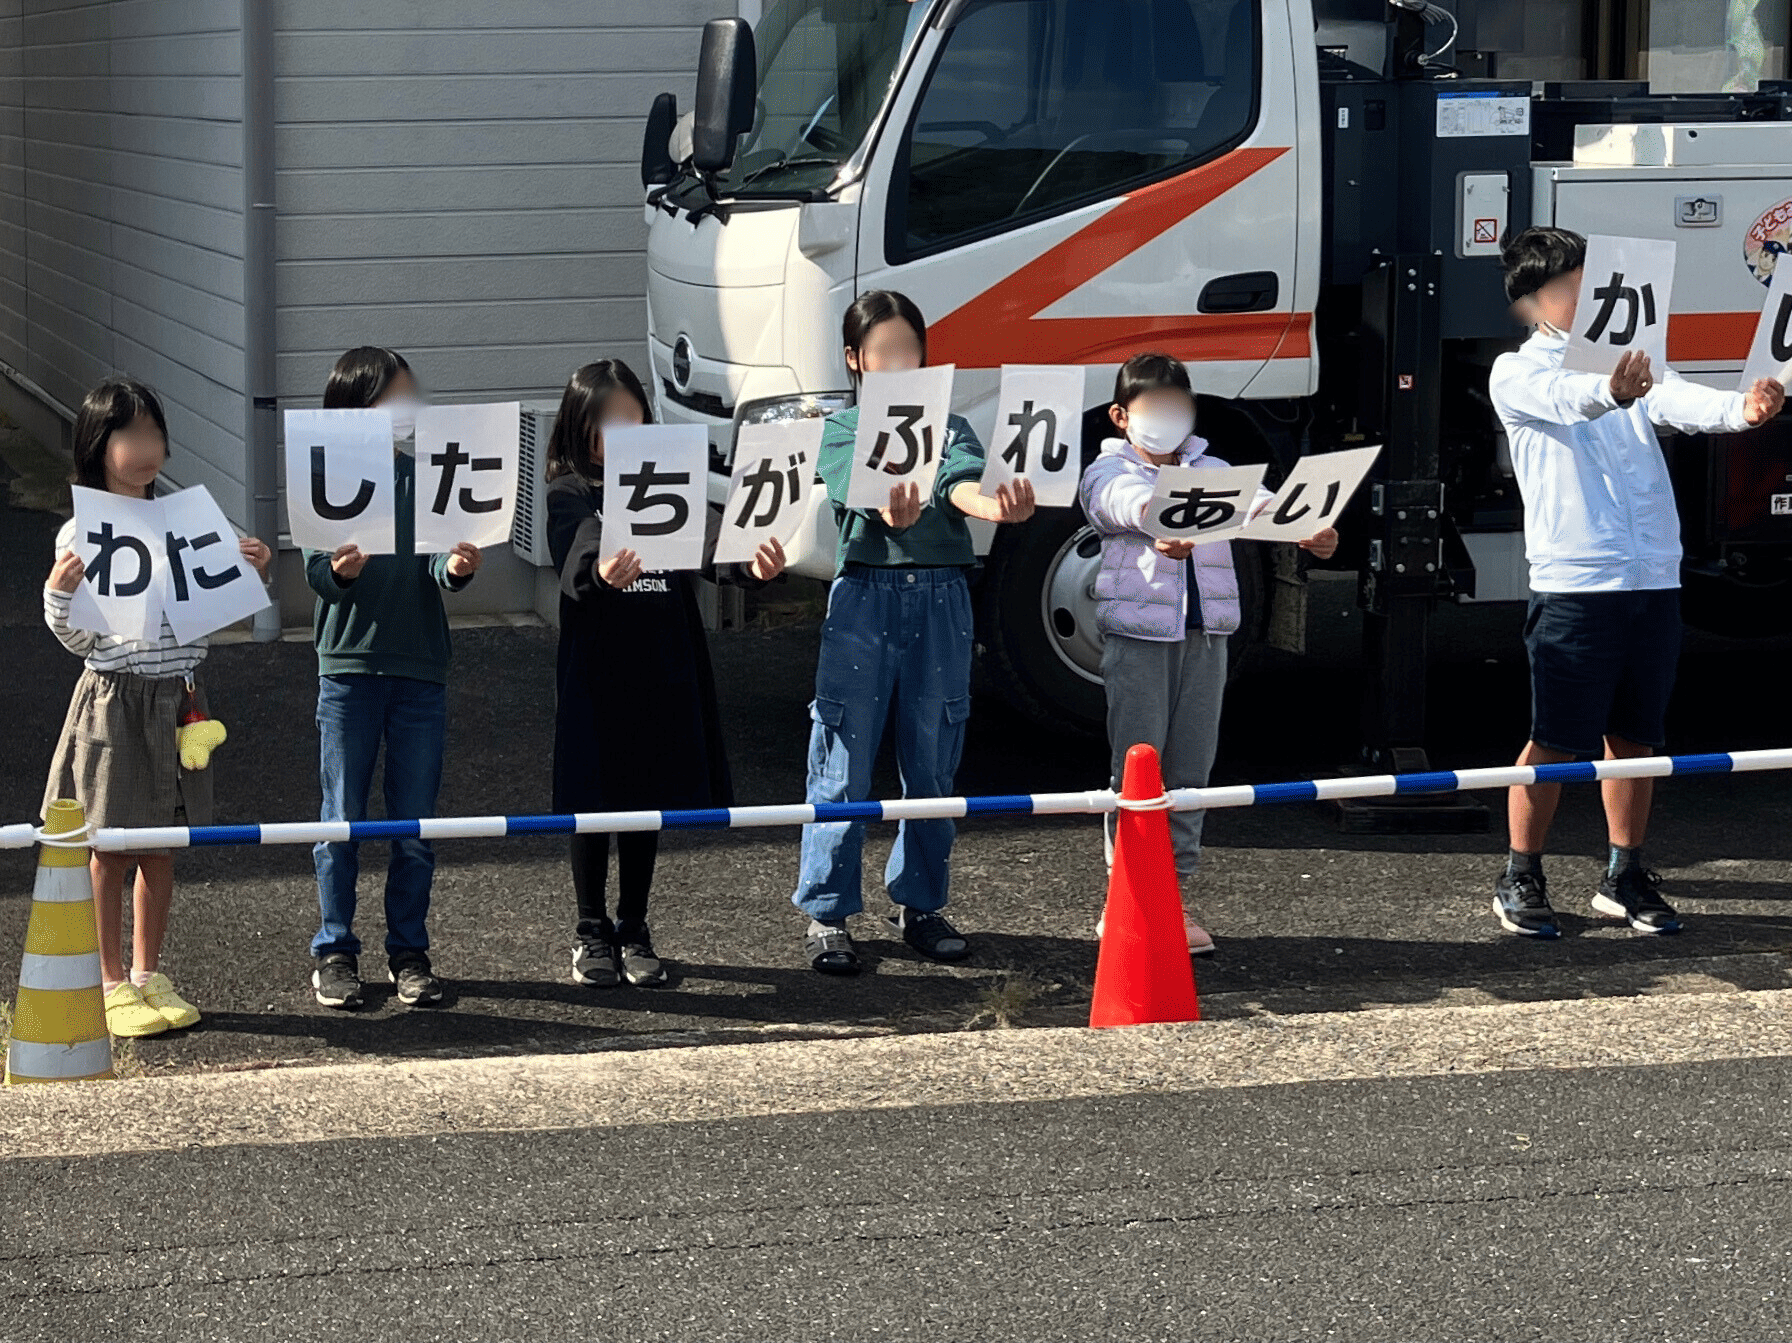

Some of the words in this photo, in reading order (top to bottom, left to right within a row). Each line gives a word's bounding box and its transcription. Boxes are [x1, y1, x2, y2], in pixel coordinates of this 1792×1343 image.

[1584, 272, 1656, 345] か
[866, 406, 932, 475] ふ
[1002, 401, 1068, 472] れ
[311, 446, 376, 520] し
[431, 442, 502, 515] た
[619, 462, 690, 536] ち
[734, 452, 806, 528] が
[1159, 488, 1241, 530] あ
[1273, 481, 1341, 525] い
[84, 522, 152, 596] わ
